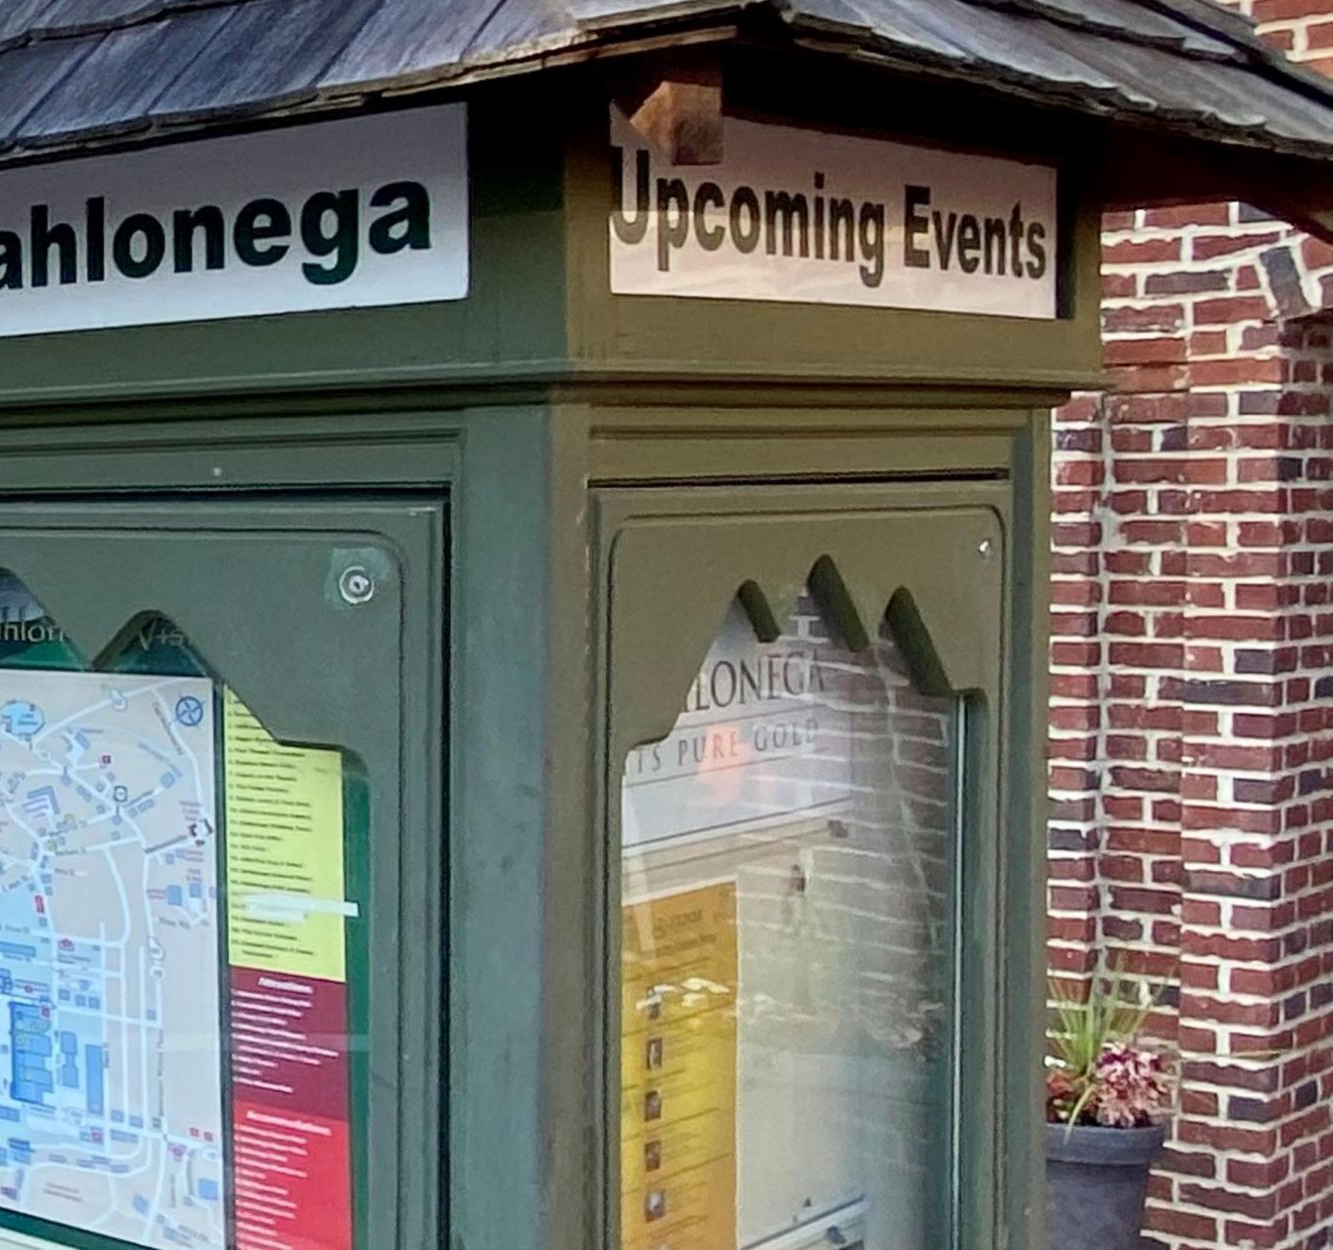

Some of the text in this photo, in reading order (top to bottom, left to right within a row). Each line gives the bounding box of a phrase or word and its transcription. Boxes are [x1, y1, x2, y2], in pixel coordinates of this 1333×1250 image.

[612, 146, 1047, 288] Upcoming Events
[677, 730, 739, 766] PURE
[753, 718, 820, 752] GOLD
